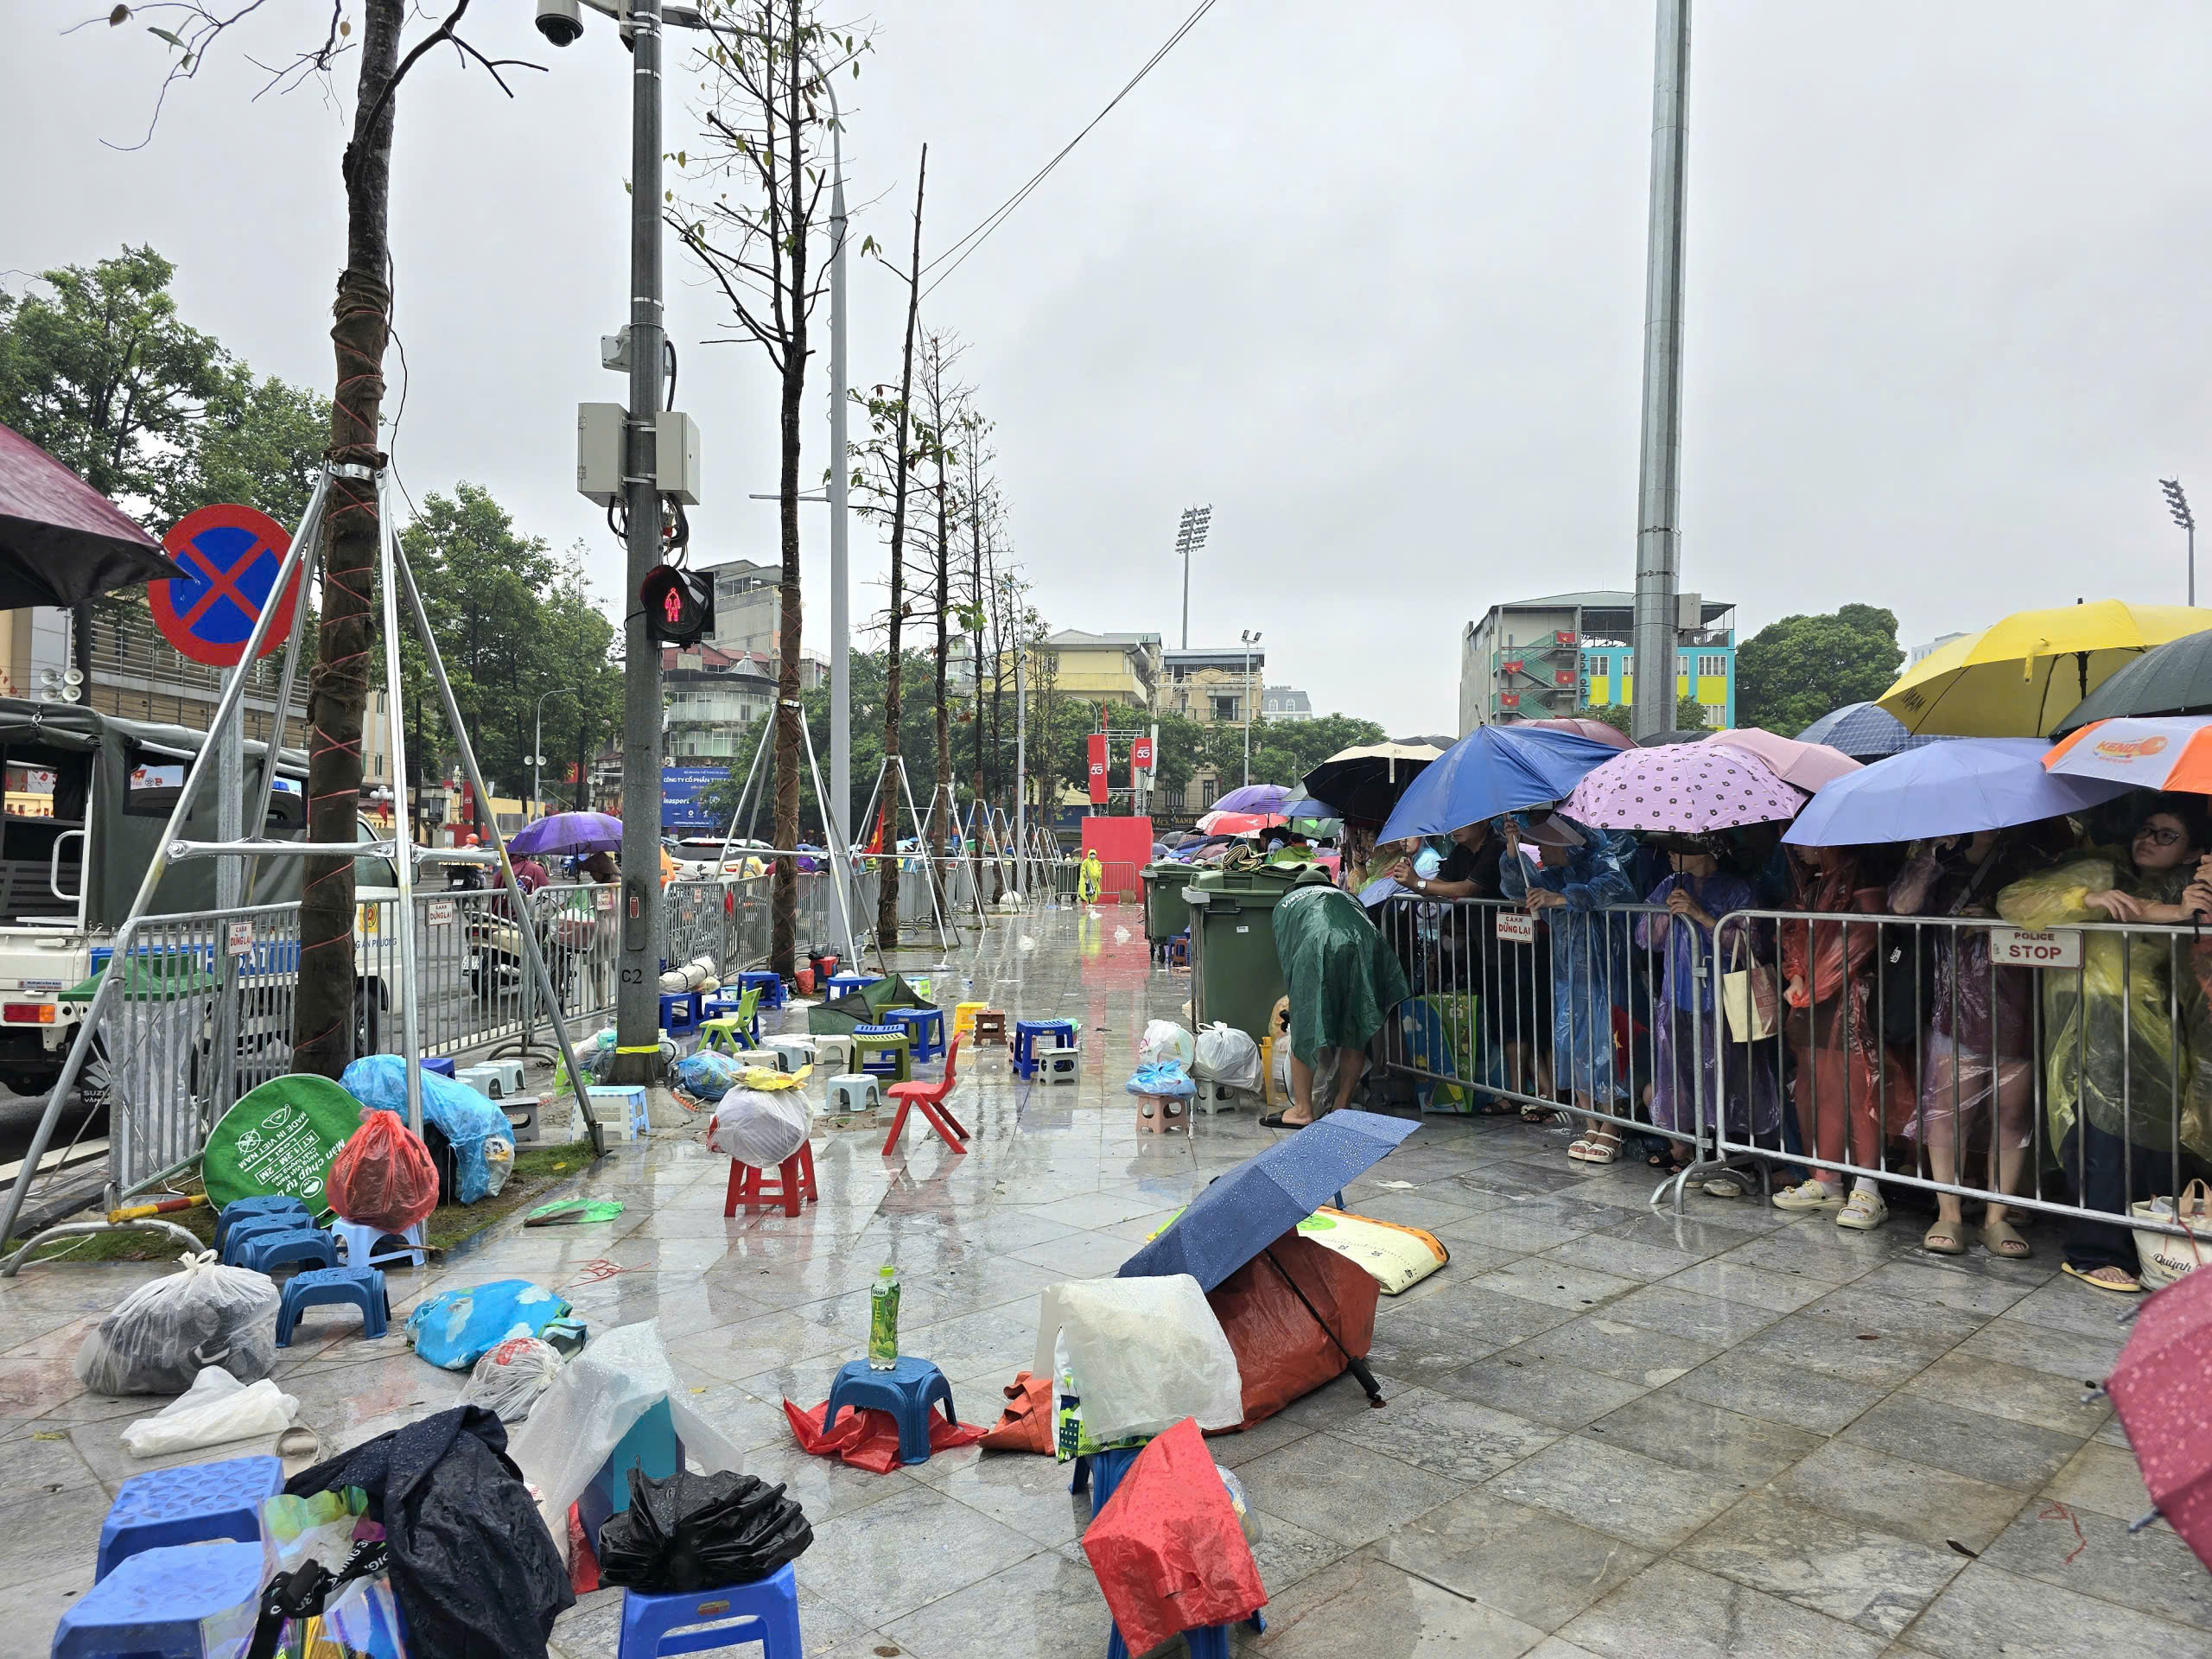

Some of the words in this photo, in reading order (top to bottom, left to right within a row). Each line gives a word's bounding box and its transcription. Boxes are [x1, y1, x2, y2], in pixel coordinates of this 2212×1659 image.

[1137, 749, 1150, 758] 5G
[1090, 766, 1103, 775] 5G
[1499, 922, 1518, 934] DỪNG
[1519, 926, 1531, 937] LẠI
[2014, 932, 2055, 941] POLICE
[2009, 945, 2062, 960] STOP
[622, 969, 642, 984] C2
[286, 1111, 307, 1132] MADE
[276, 1130, 287, 1140] IN
[302, 1135, 315, 1147] KT
[259, 1139, 277, 1154] VIET
[276, 1138, 296, 1156] Loại
[302, 1147, 316, 1160] Chất
[326, 1139, 346, 1160] Màn
[238, 1152, 258, 1168] NAM
[279, 1147, 299, 1165] 1.2M
[302, 1152, 319, 1166] Hàng
[259, 1166, 274, 1180] 2M
[290, 1166, 302, 1175] Việt
[299, 1159, 324, 1180] chụp
[271, 1173, 283, 1182] cao
[276, 1174, 290, 1186] Nam
[286, 1179, 298, 1192] tự
[2153, 1253, 2191, 1272] Quỳnh
